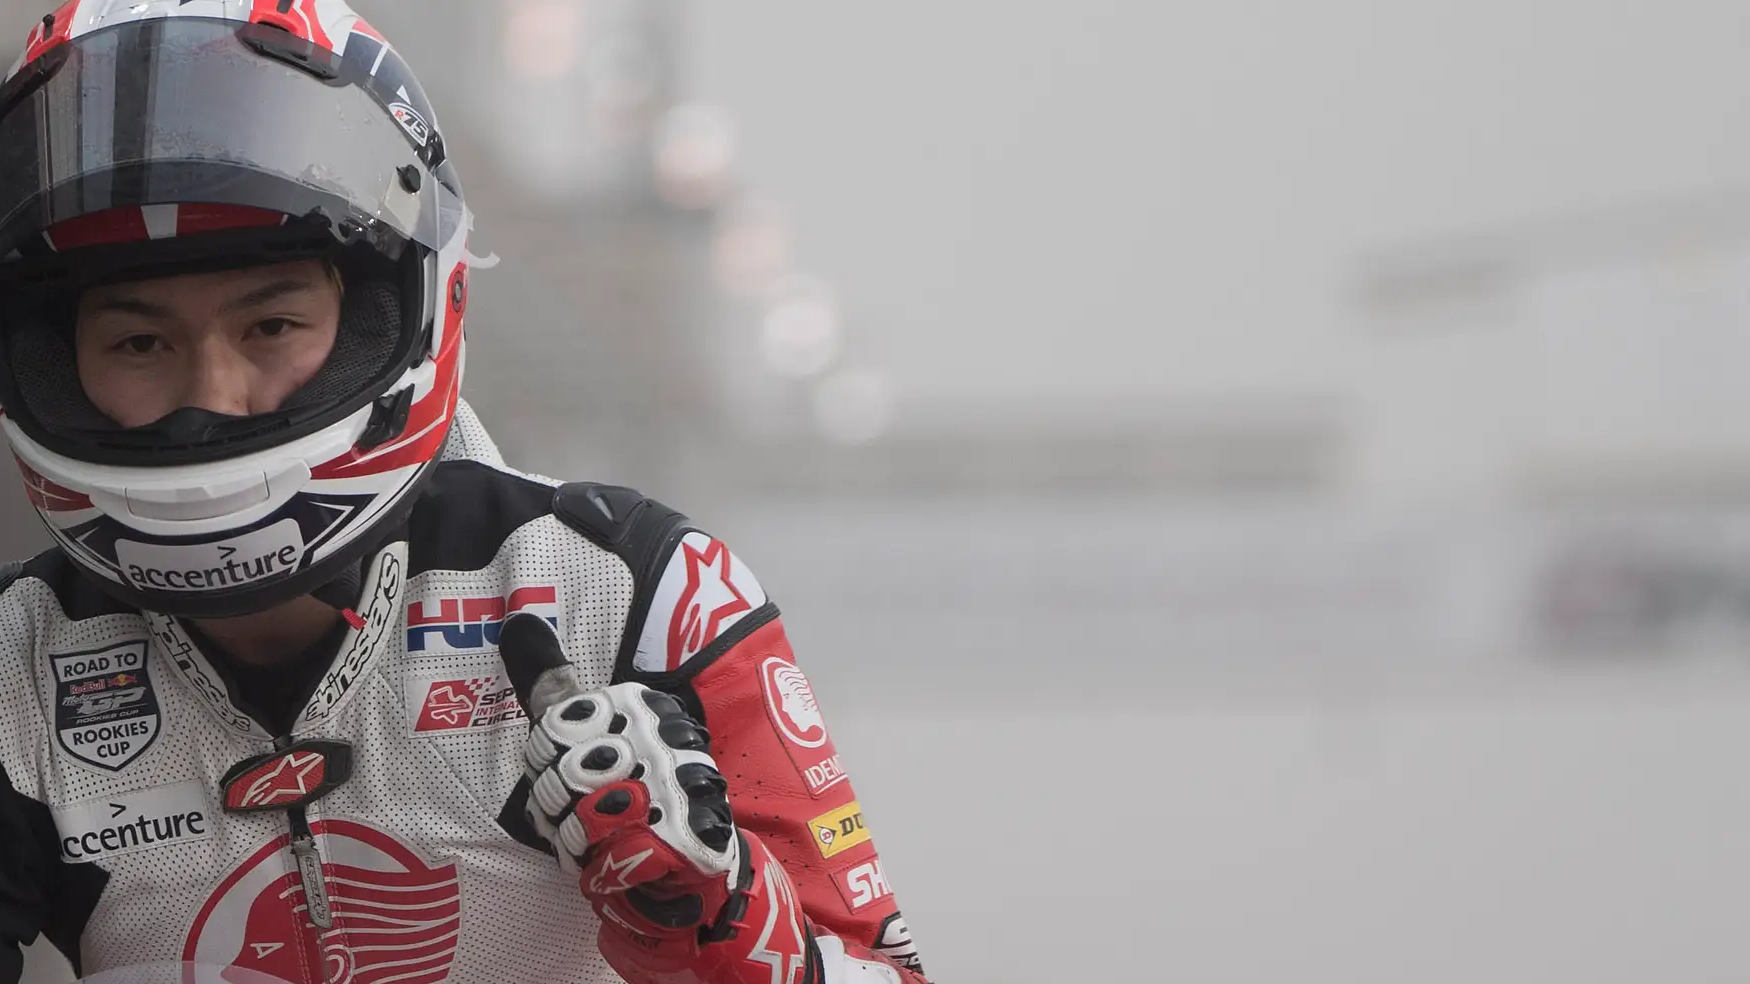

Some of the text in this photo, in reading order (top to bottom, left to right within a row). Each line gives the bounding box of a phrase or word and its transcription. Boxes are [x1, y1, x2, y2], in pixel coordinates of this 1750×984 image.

[128, 545, 297, 588] accenture
[63, 652, 138, 678] ROAD TO
[72, 720, 149, 746] ROOKIES
[96, 741, 131, 758] CUP
[61, 811, 205, 859] ccenture
